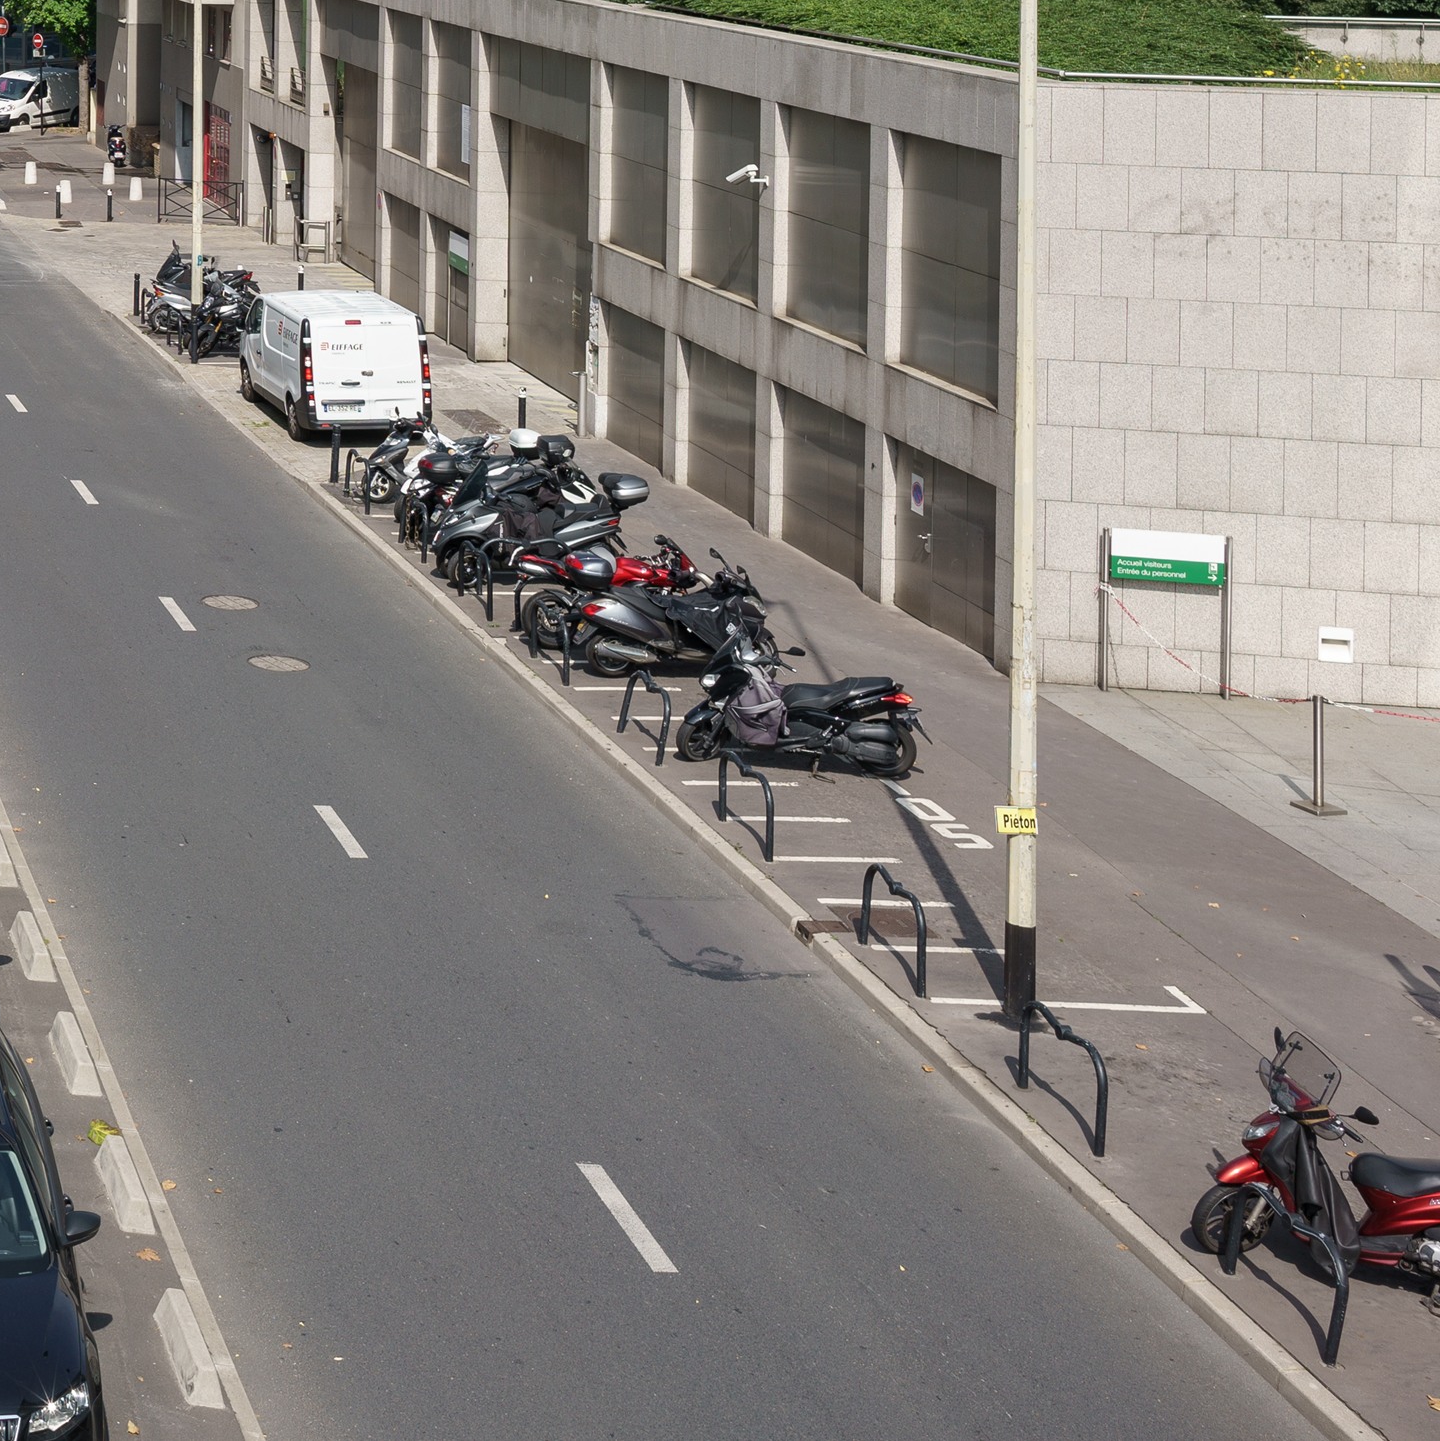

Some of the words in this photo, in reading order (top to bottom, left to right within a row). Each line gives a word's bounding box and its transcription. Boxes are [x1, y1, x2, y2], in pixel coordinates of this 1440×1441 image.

[283, 327, 298, 344] EIFFAGE
[331, 343, 363, 351] EIFFAGE
[1117, 558, 1142, 566] Accueil
[1143, 560, 1172, 569] visiteurs
[1117, 567, 1140, 575] Entrée
[1152, 570, 1187, 579] personnel
[1003, 814, 1036, 829] Piéton
